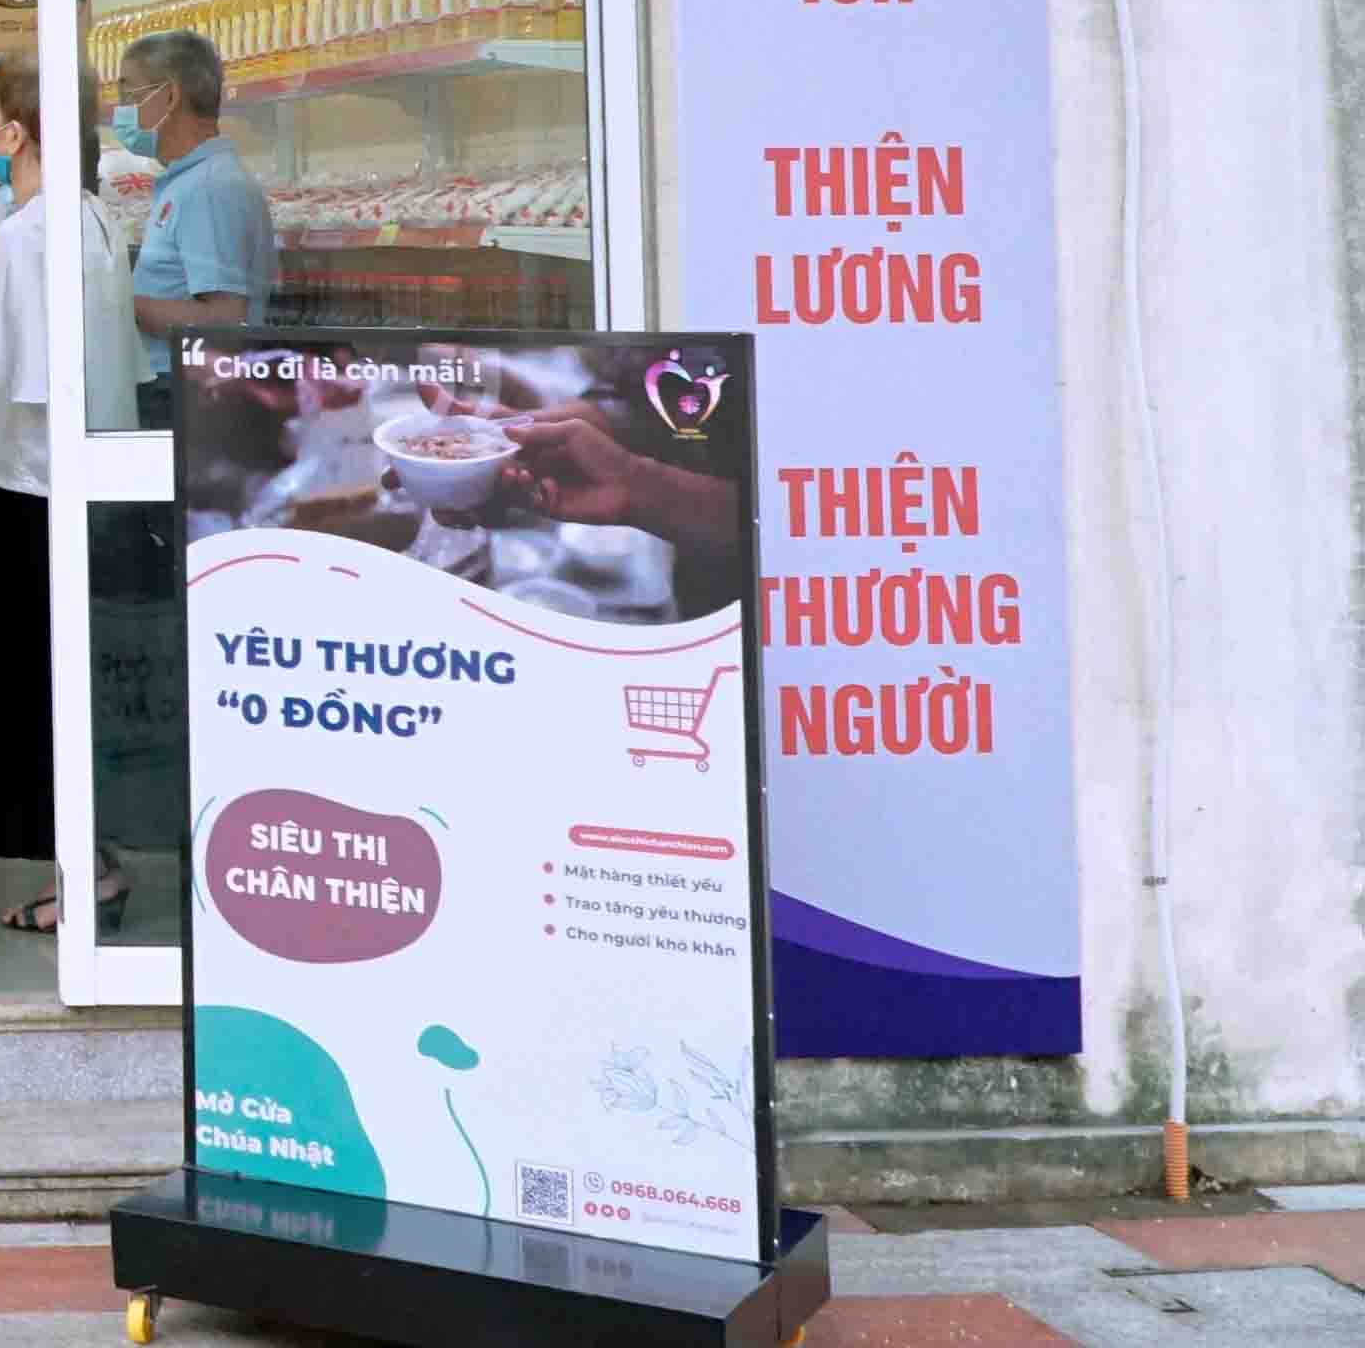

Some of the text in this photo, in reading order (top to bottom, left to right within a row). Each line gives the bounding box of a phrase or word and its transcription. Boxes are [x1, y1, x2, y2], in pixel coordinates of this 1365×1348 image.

[764, 132, 963, 232] THIỆN
[756, 247, 981, 324] LƯƠNG
[214, 356, 269, 380] Cho
[278, 356, 302, 382] đi
[313, 356, 336, 382] là
[345, 361, 399, 382] còn
[412, 357, 464, 382] mãi
[778, 452, 979, 553] THIỆN
[216, 627, 515, 684] YÊU THƯƠNG
[780, 666, 992, 756] NGƯỜI
[251, 820, 387, 865] SIÊU THỊ
[226, 866, 424, 914] CHÂN THIỆN
[566, 896, 601, 911] Trao
[566, 926, 598, 942] Cho
[196, 1090, 292, 1124] Mở Cửa
[196, 1125, 334, 1168] Chúa Nhật
[611, 1180, 742, 1214] 0968.064.668
